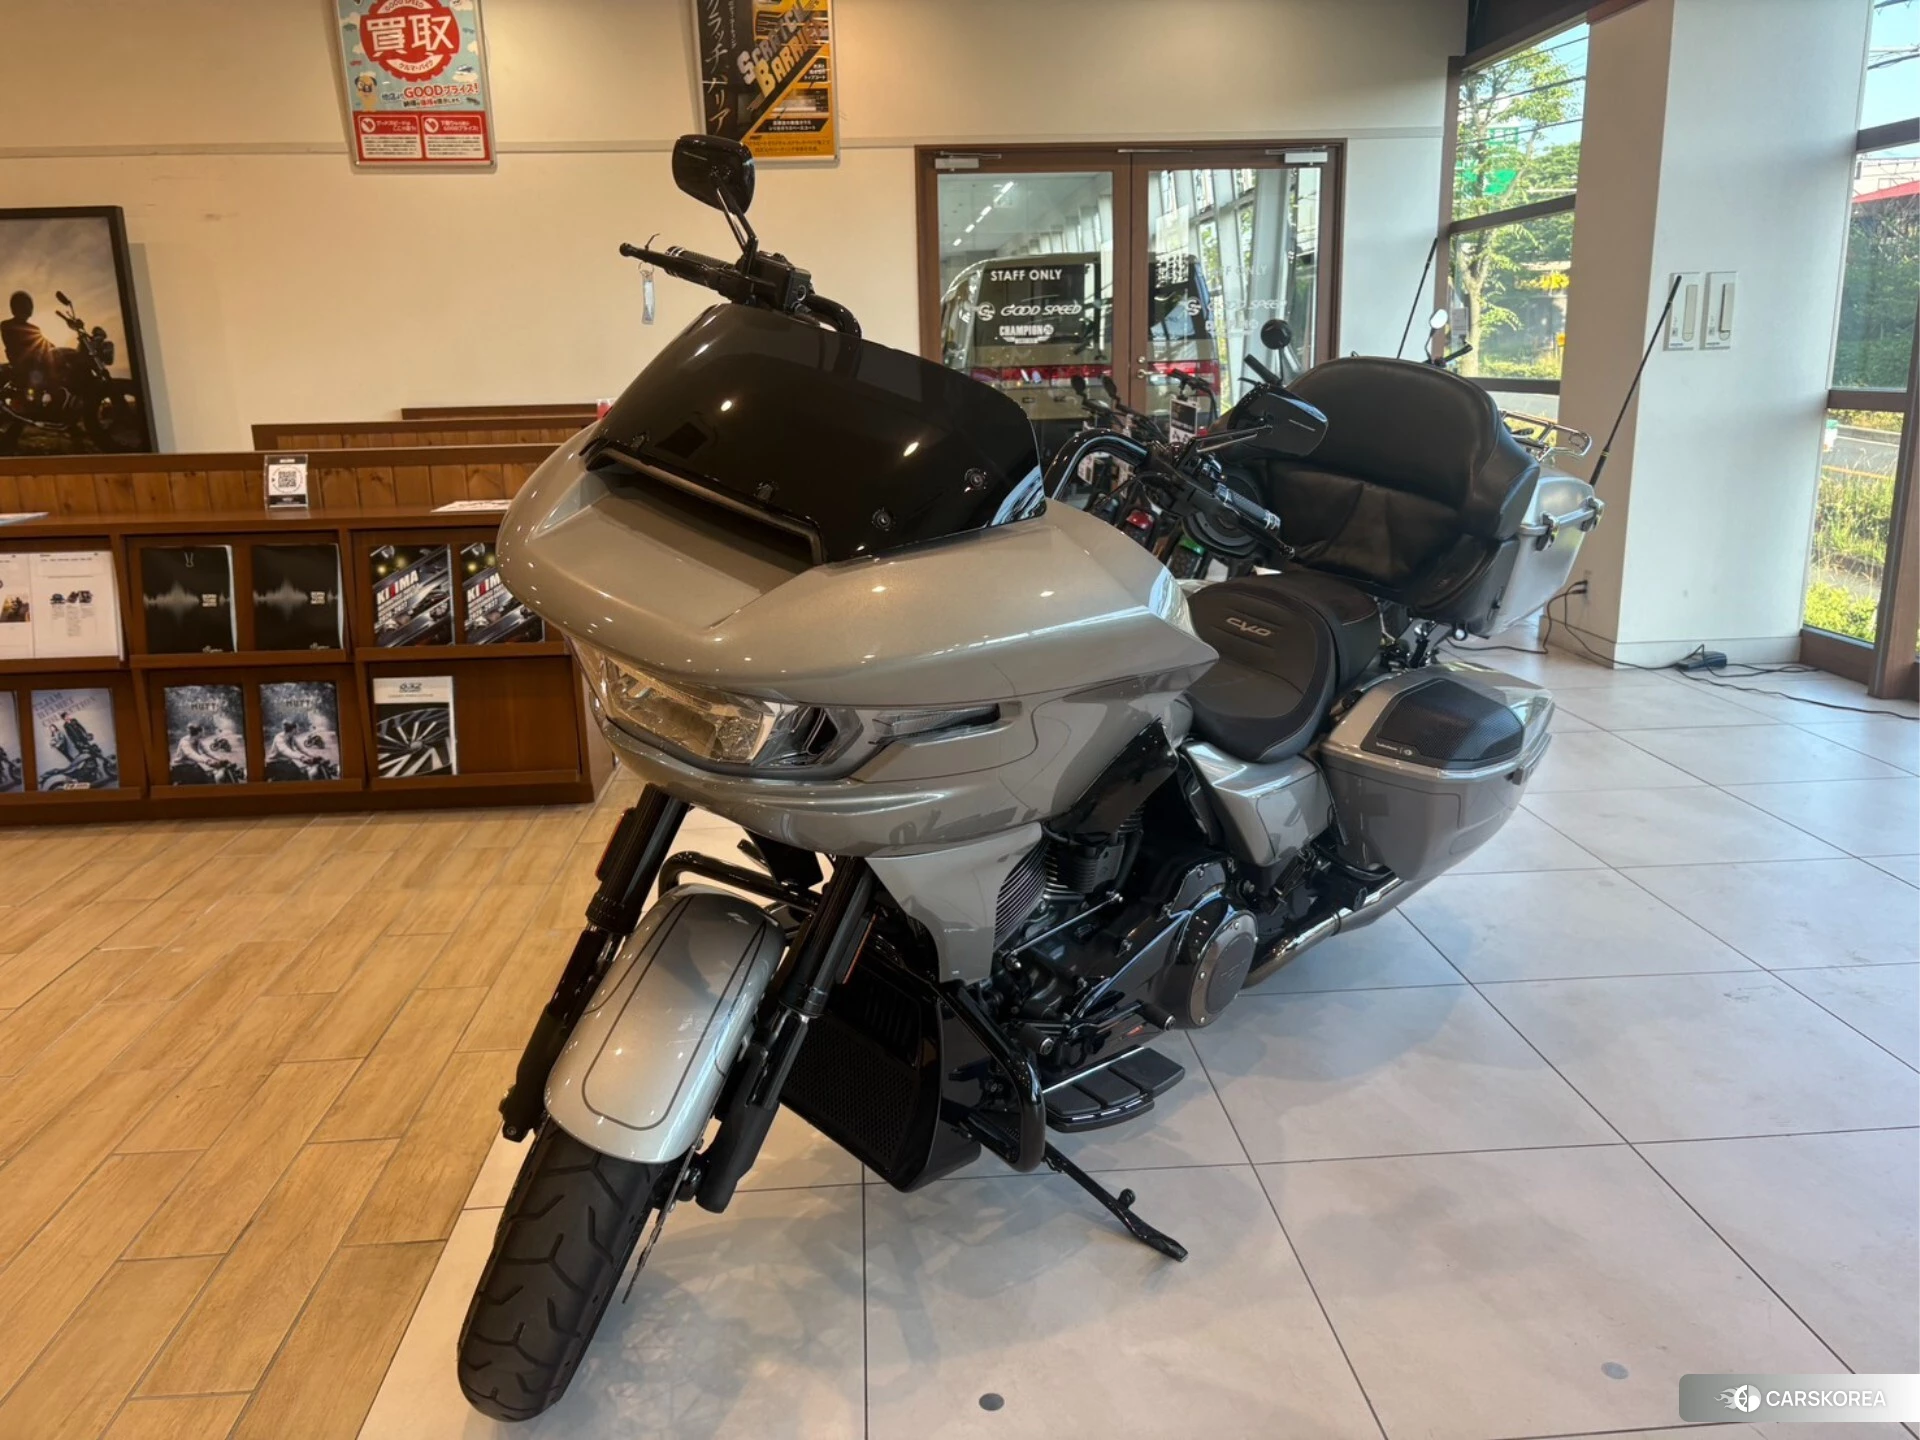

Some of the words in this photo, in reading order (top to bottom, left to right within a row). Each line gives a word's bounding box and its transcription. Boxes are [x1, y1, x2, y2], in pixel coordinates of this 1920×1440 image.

[366, 13, 455, 57] 買取
[990, 269, 1026, 281] STAFF
[1029, 268, 1063, 281] ONLY
[1000, 303, 1041, 317] GOOD
[1041, 299, 1083, 315] SPEED
[999, 324, 1043, 336] CHAMPION
